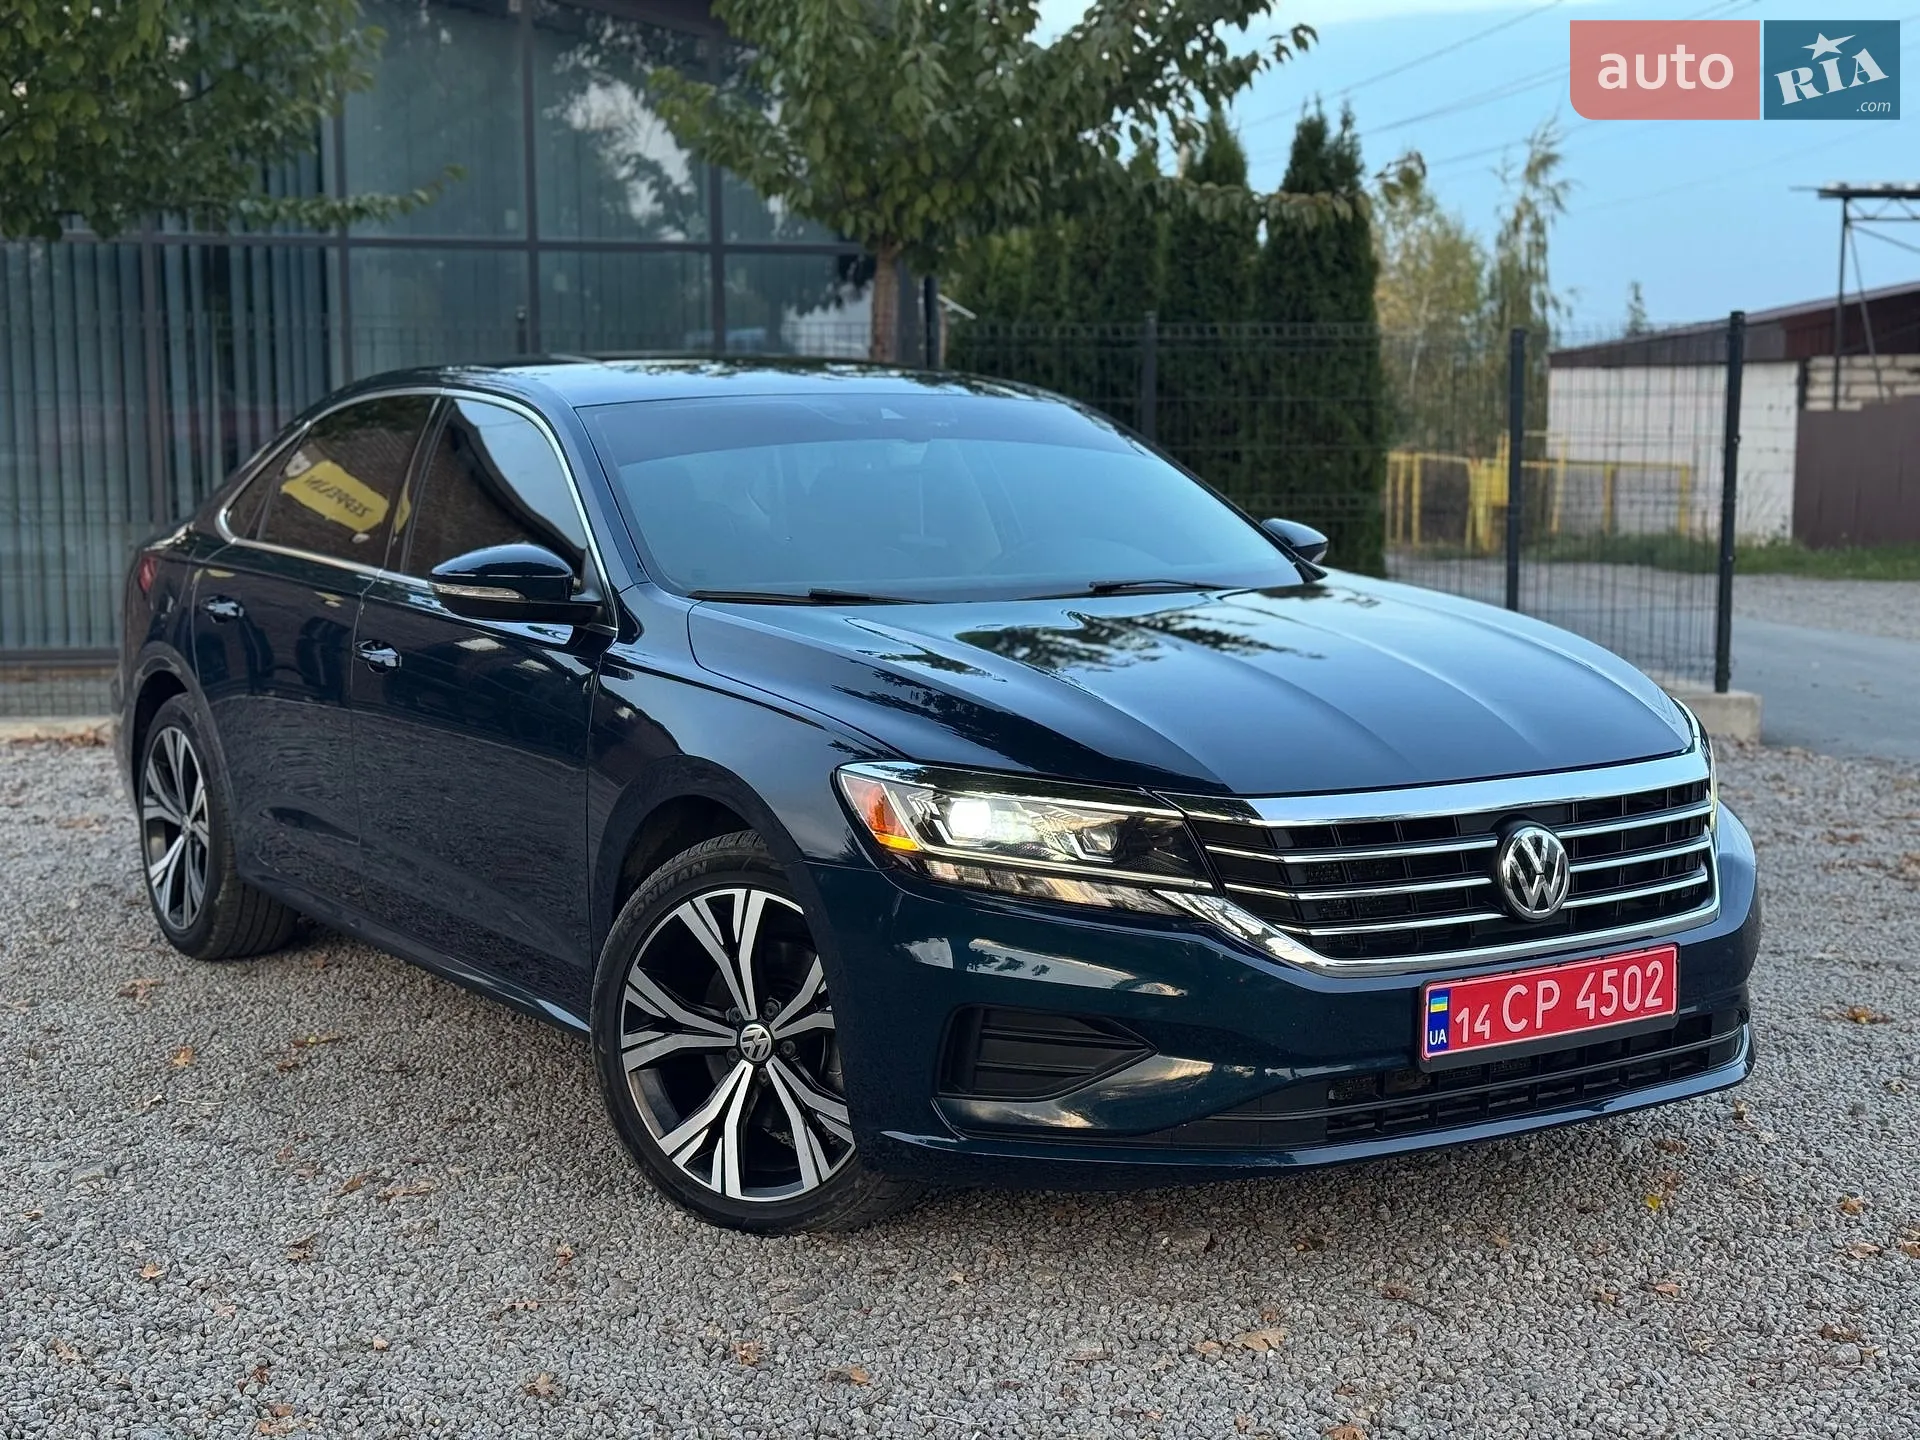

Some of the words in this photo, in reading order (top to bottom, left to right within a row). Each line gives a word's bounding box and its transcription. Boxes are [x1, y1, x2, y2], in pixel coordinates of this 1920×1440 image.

[1454, 1003, 1492, 1044] 14
[1502, 979, 1562, 1034] CP
[1575, 959, 1665, 1021] 4502
[1428, 1029, 1448, 1047] UA
